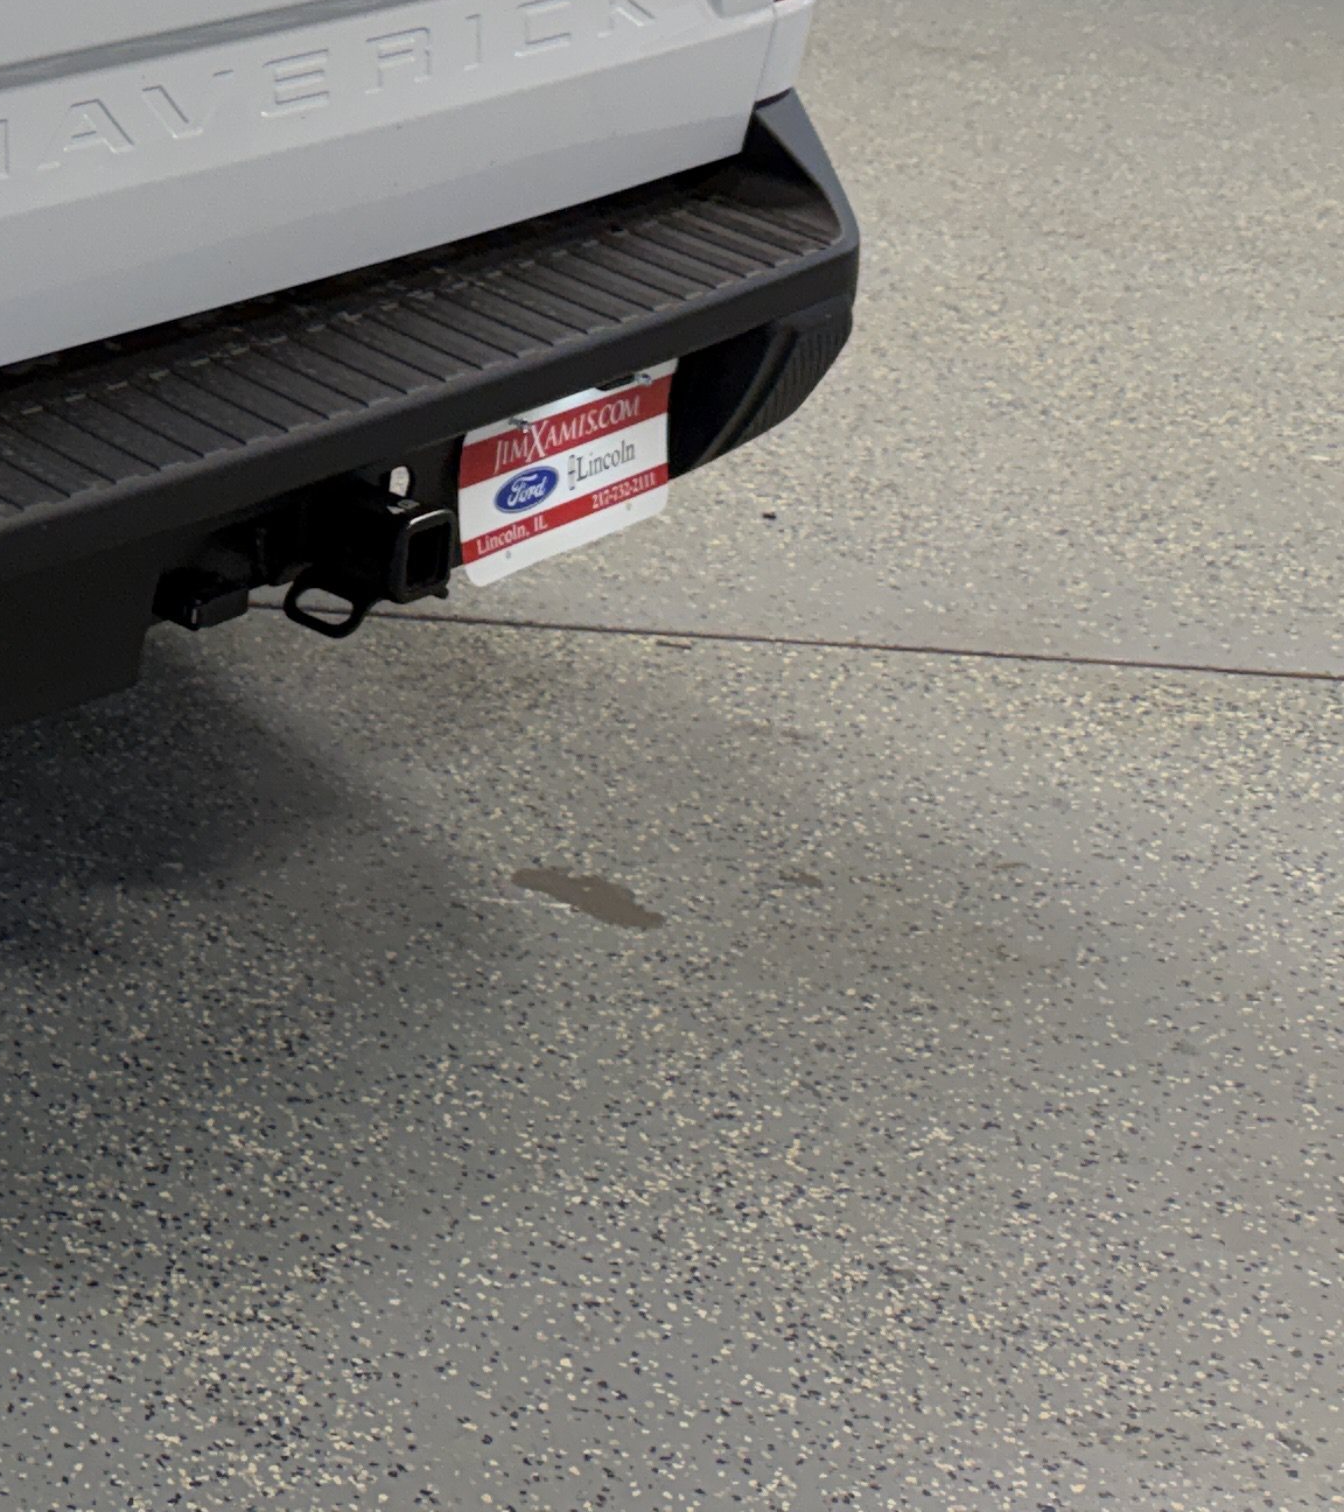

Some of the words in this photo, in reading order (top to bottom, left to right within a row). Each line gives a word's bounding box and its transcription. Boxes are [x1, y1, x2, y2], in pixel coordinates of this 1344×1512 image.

[576, 440, 635, 481] Lincoln
[507, 473, 550, 507] Ford
[533, 514, 549, 532] IL
